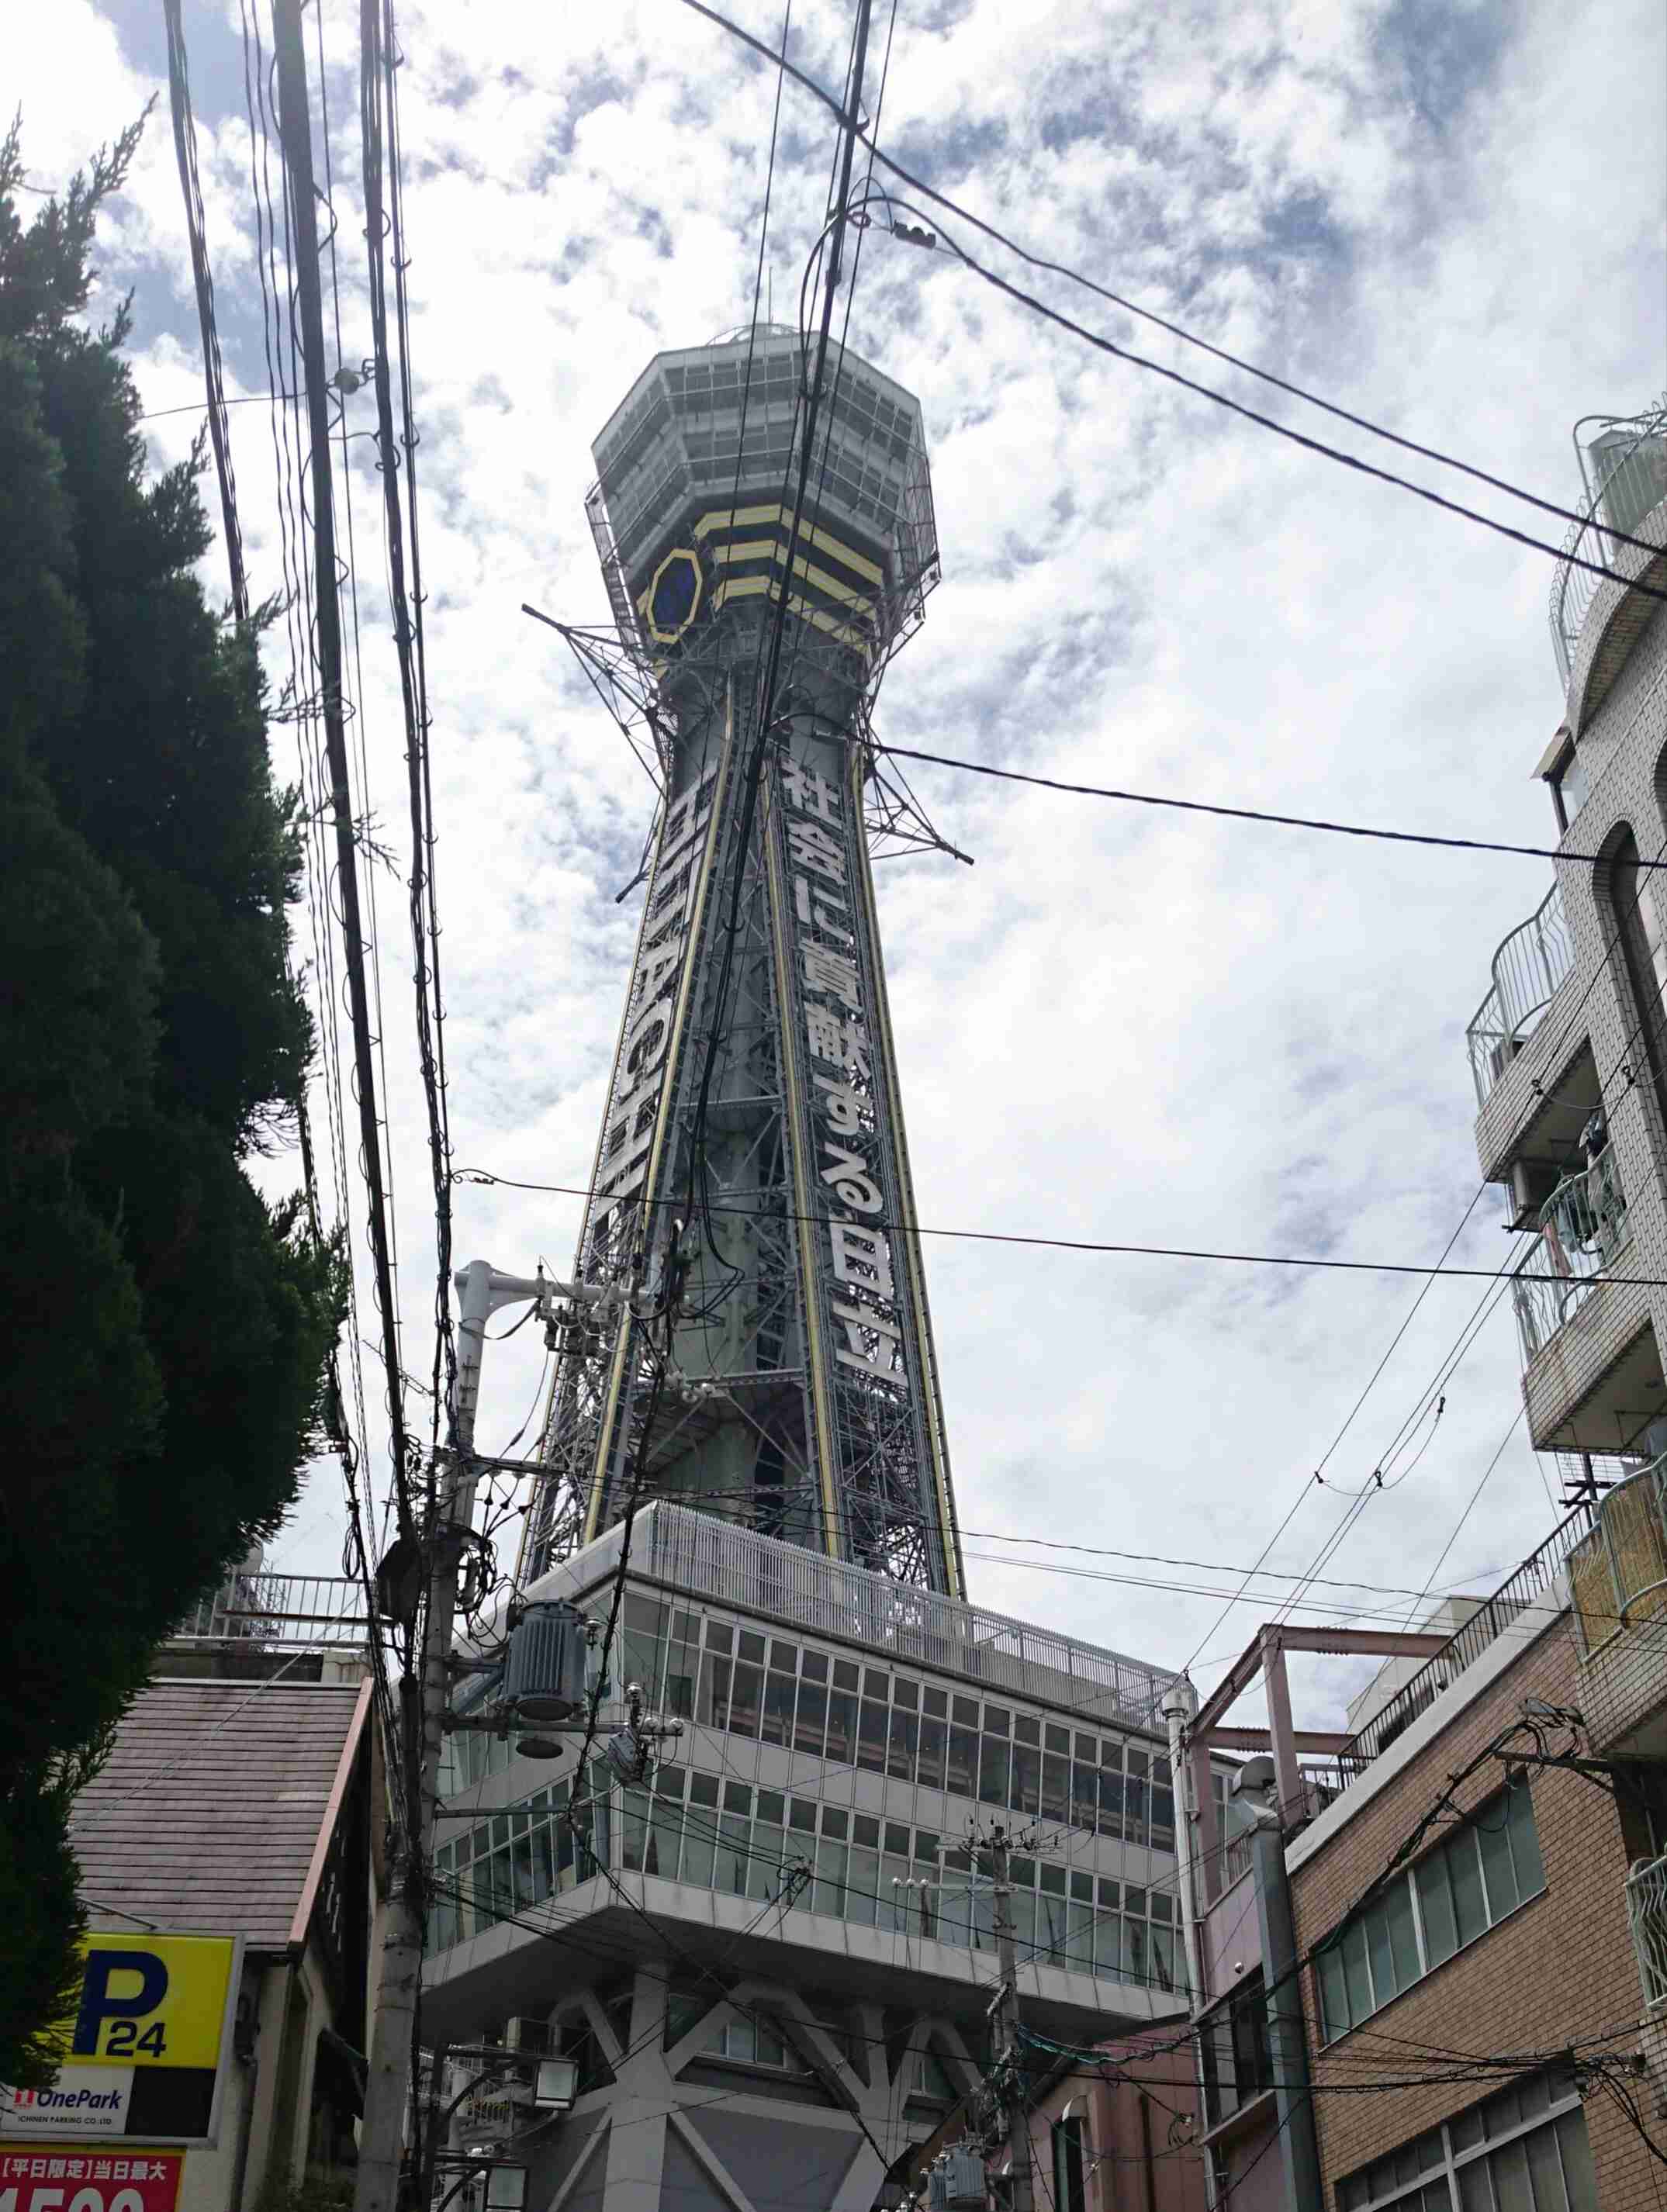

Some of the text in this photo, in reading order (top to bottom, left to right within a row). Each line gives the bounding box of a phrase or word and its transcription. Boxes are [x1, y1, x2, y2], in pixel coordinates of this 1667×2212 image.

[592, 759, 719, 1225] HITACHI
[781, 757, 909, 1388] 社会に貢献する日立
[72, 1949, 168, 2055] P
[105, 2020, 168, 2058] 24
[37, 2089, 123, 2110] OnePark
